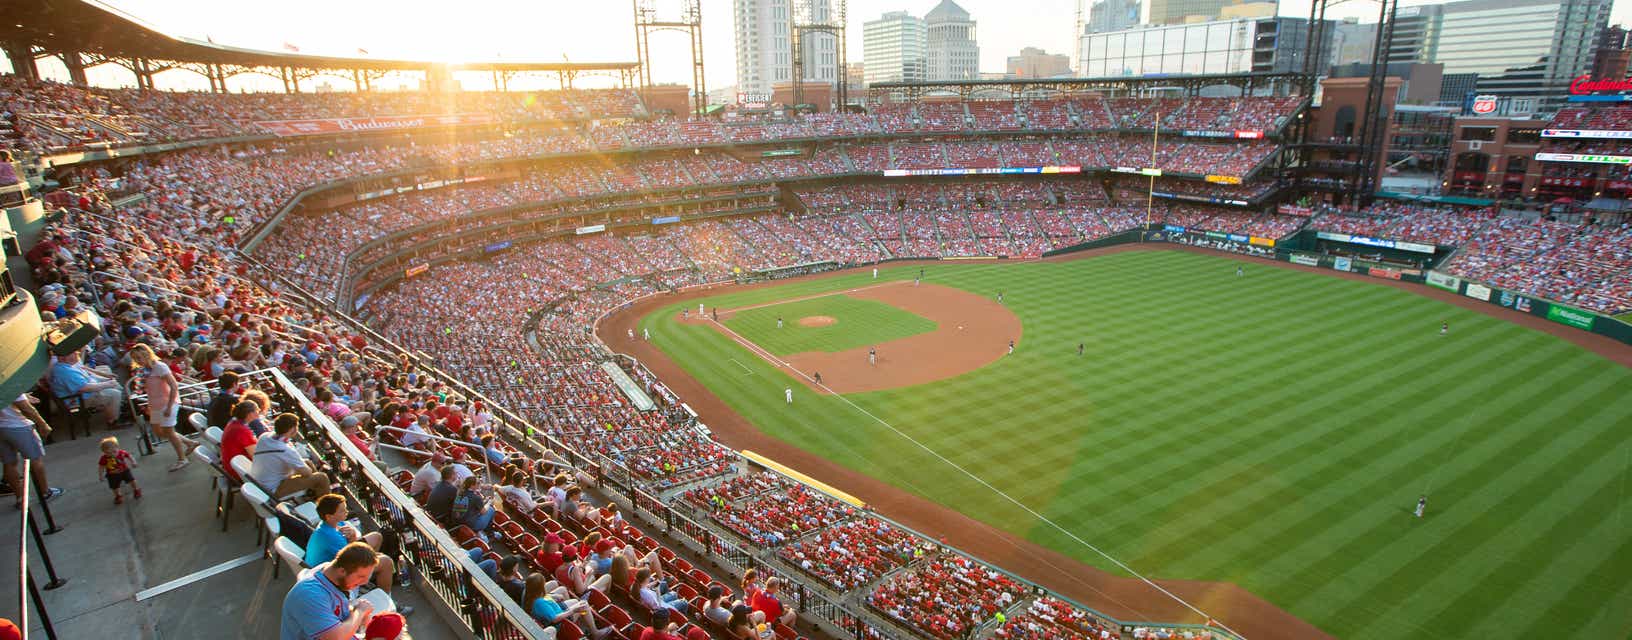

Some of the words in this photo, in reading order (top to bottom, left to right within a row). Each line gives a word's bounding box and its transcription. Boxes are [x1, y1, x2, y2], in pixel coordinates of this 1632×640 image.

[1475, 102, 1492, 111] 66
[336, 116, 424, 130] Budweiser
[1560, 310, 1593, 324] National
